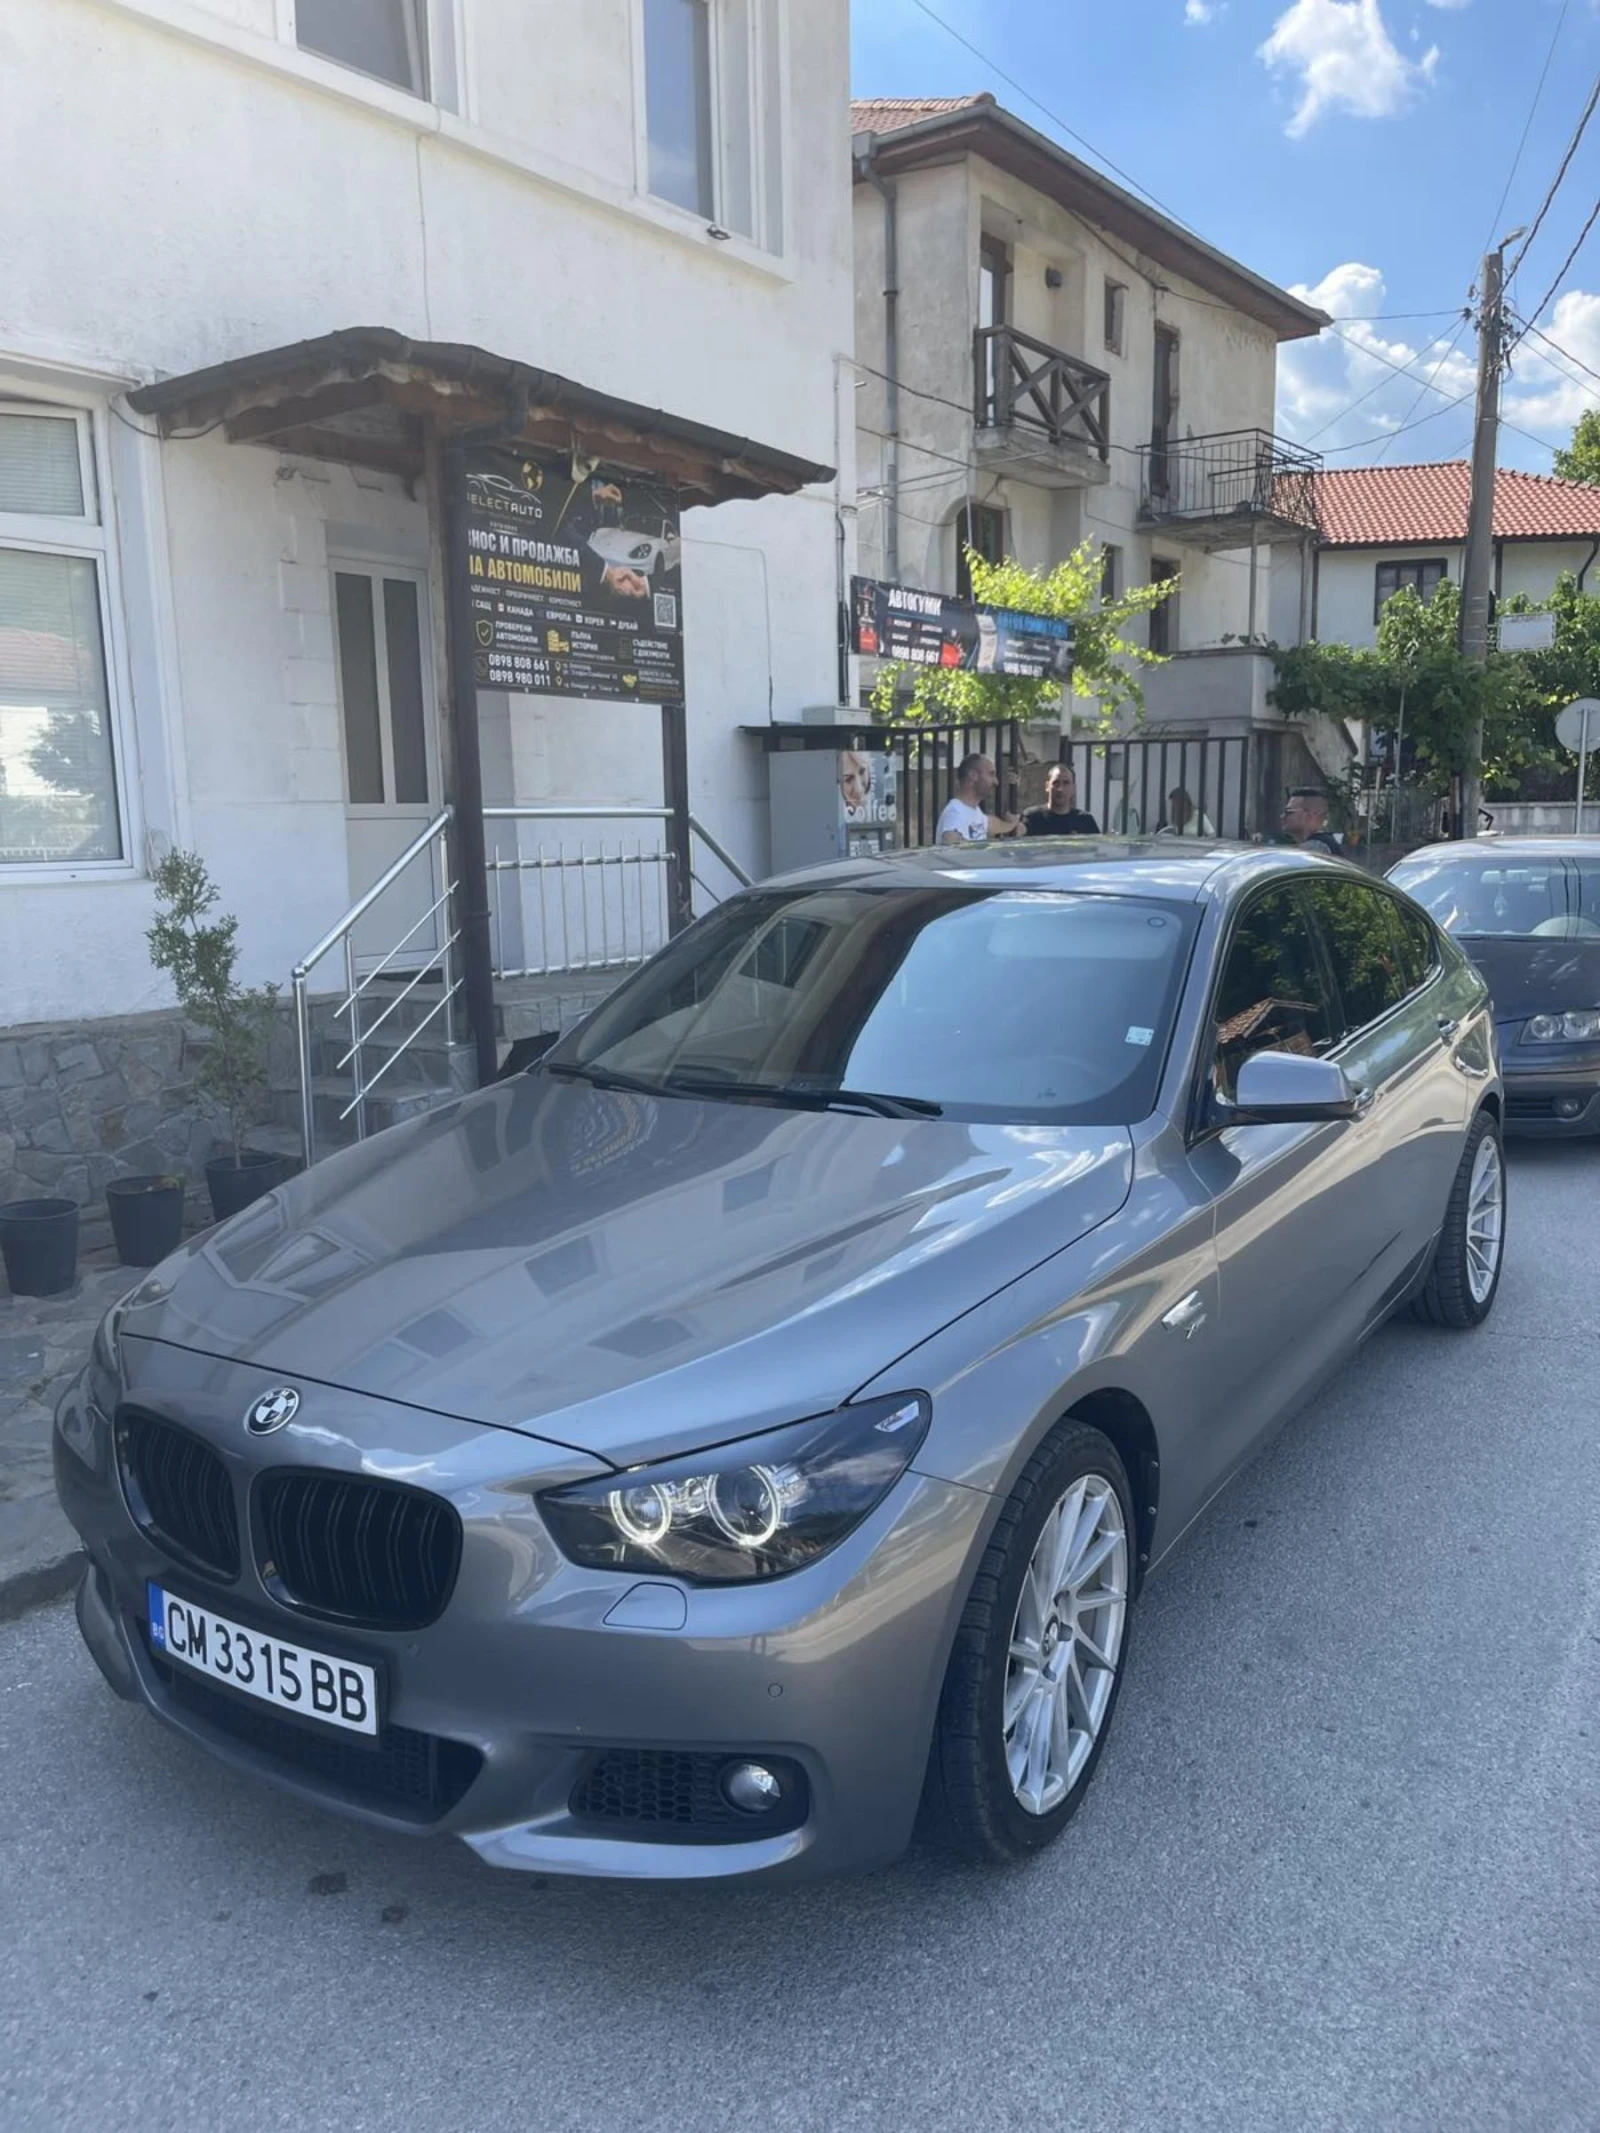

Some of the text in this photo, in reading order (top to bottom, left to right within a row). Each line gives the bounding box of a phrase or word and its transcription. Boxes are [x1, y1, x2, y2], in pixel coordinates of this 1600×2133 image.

[500, 535, 510, 555] И
[512, 537, 580, 568] ПРОДАЖБА
[487, 557, 581, 593] АВТОМОБИЛИ
[506, 605, 534, 617] КАНАДА
[546, 610, 572, 622] ЕВРОПА
[887, 588, 942, 617] АВТОГУМИ
[488, 653, 513, 668] 0898
[513, 656, 533, 670] 808
[533, 659, 550, 672] 661
[489, 669, 514, 683] 0898
[514, 671, 534, 685] 980
[534, 673, 551, 687] 011
[152, 1622, 166, 1641] BG
[167, 1601, 368, 1723] CM 3315 BB
